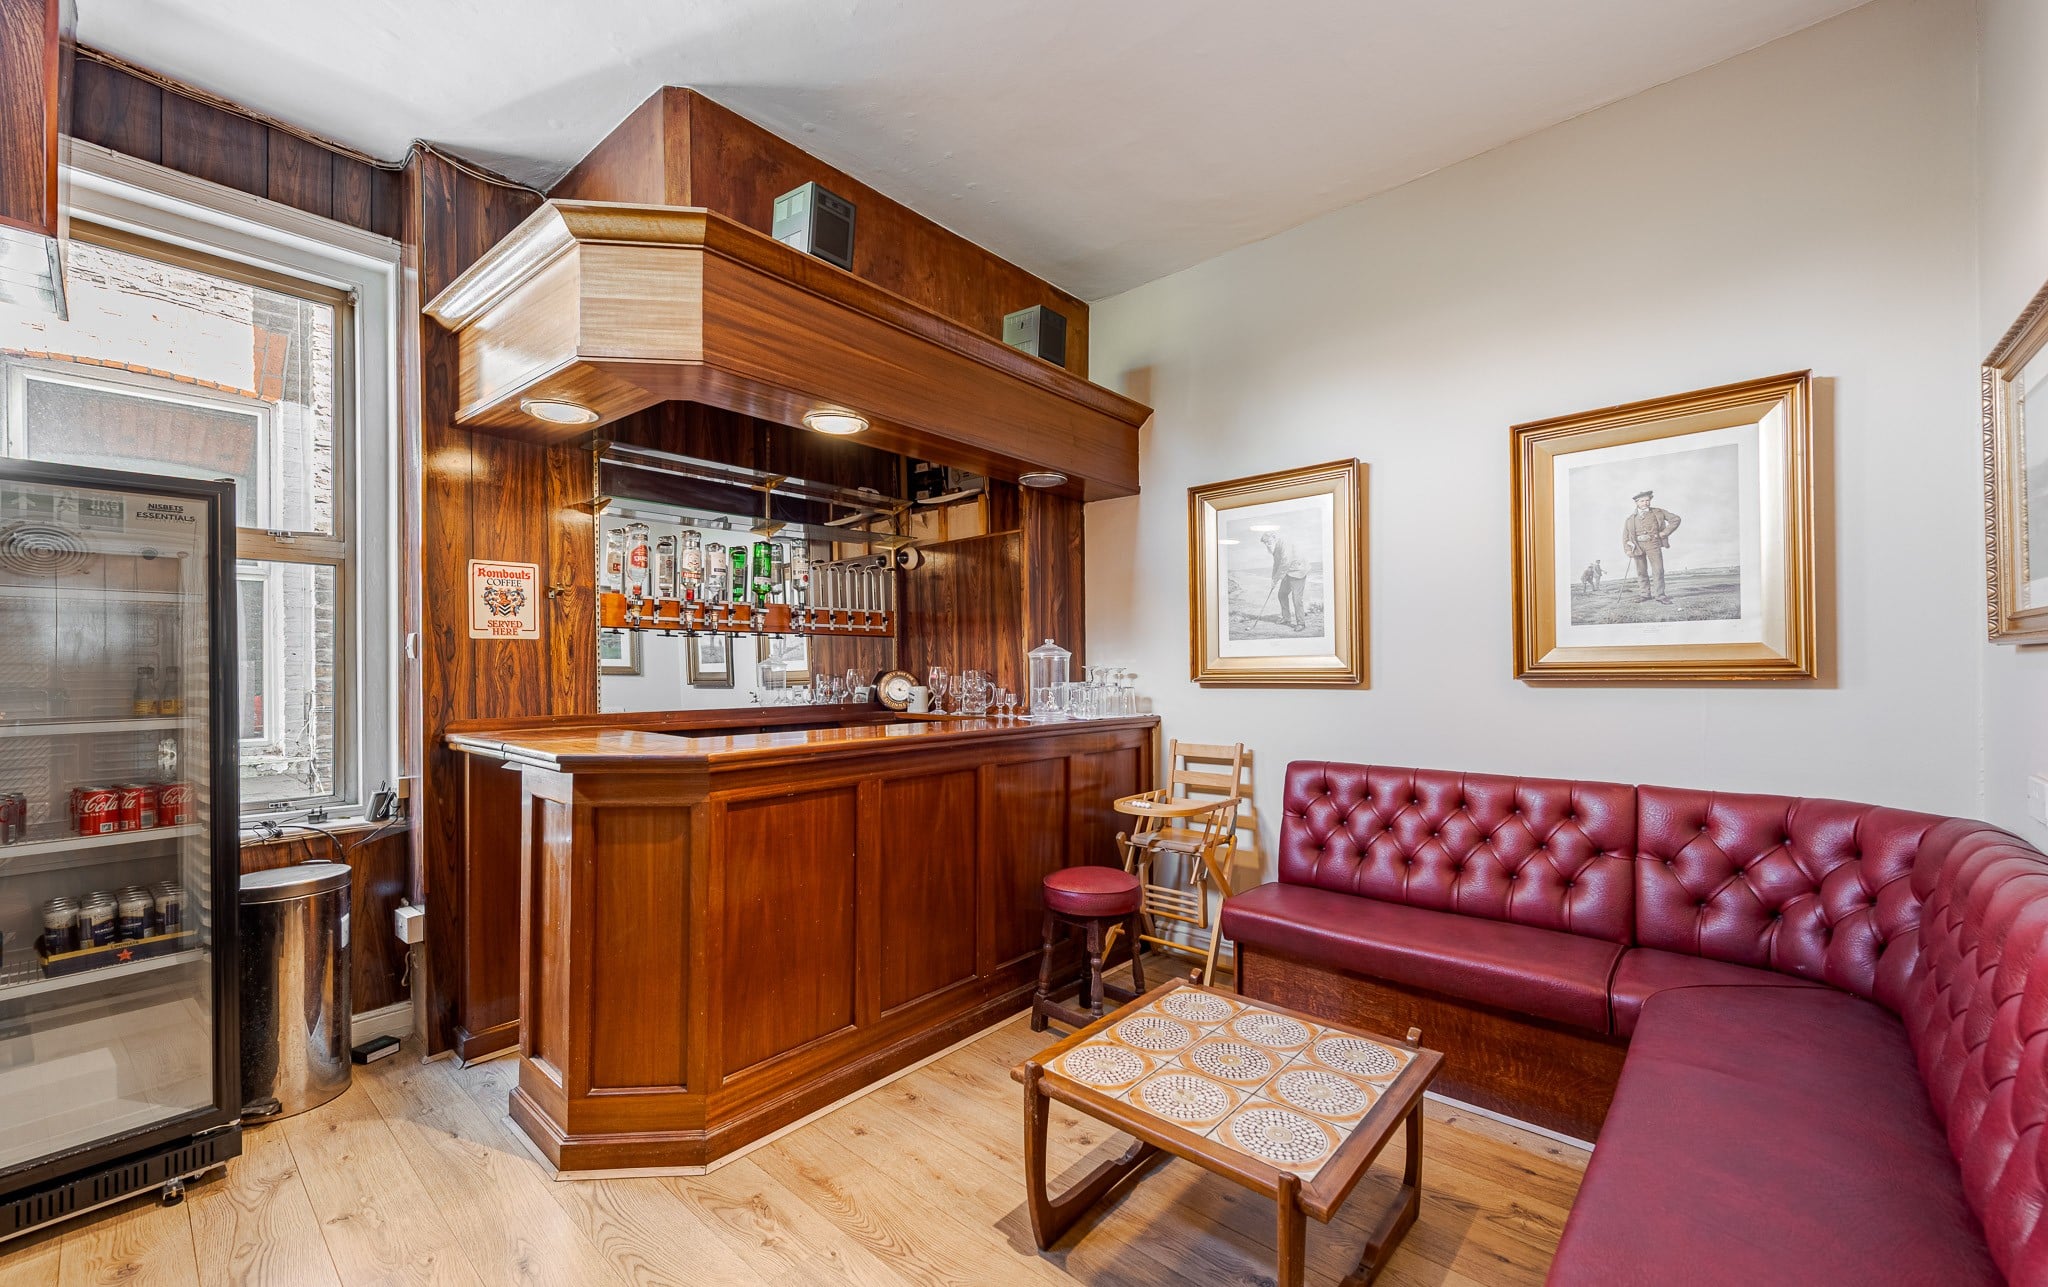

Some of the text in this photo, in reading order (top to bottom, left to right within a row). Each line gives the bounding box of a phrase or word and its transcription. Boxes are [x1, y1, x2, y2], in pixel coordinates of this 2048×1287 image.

[148, 503, 183, 512] NISBETS
[136, 511, 196, 522] ESSENTIALS
[477, 567, 531, 580] Rombouts
[486, 578, 522, 587] COFFEE
[487, 620, 523, 628] SERVED
[492, 628, 519, 636] HERE
